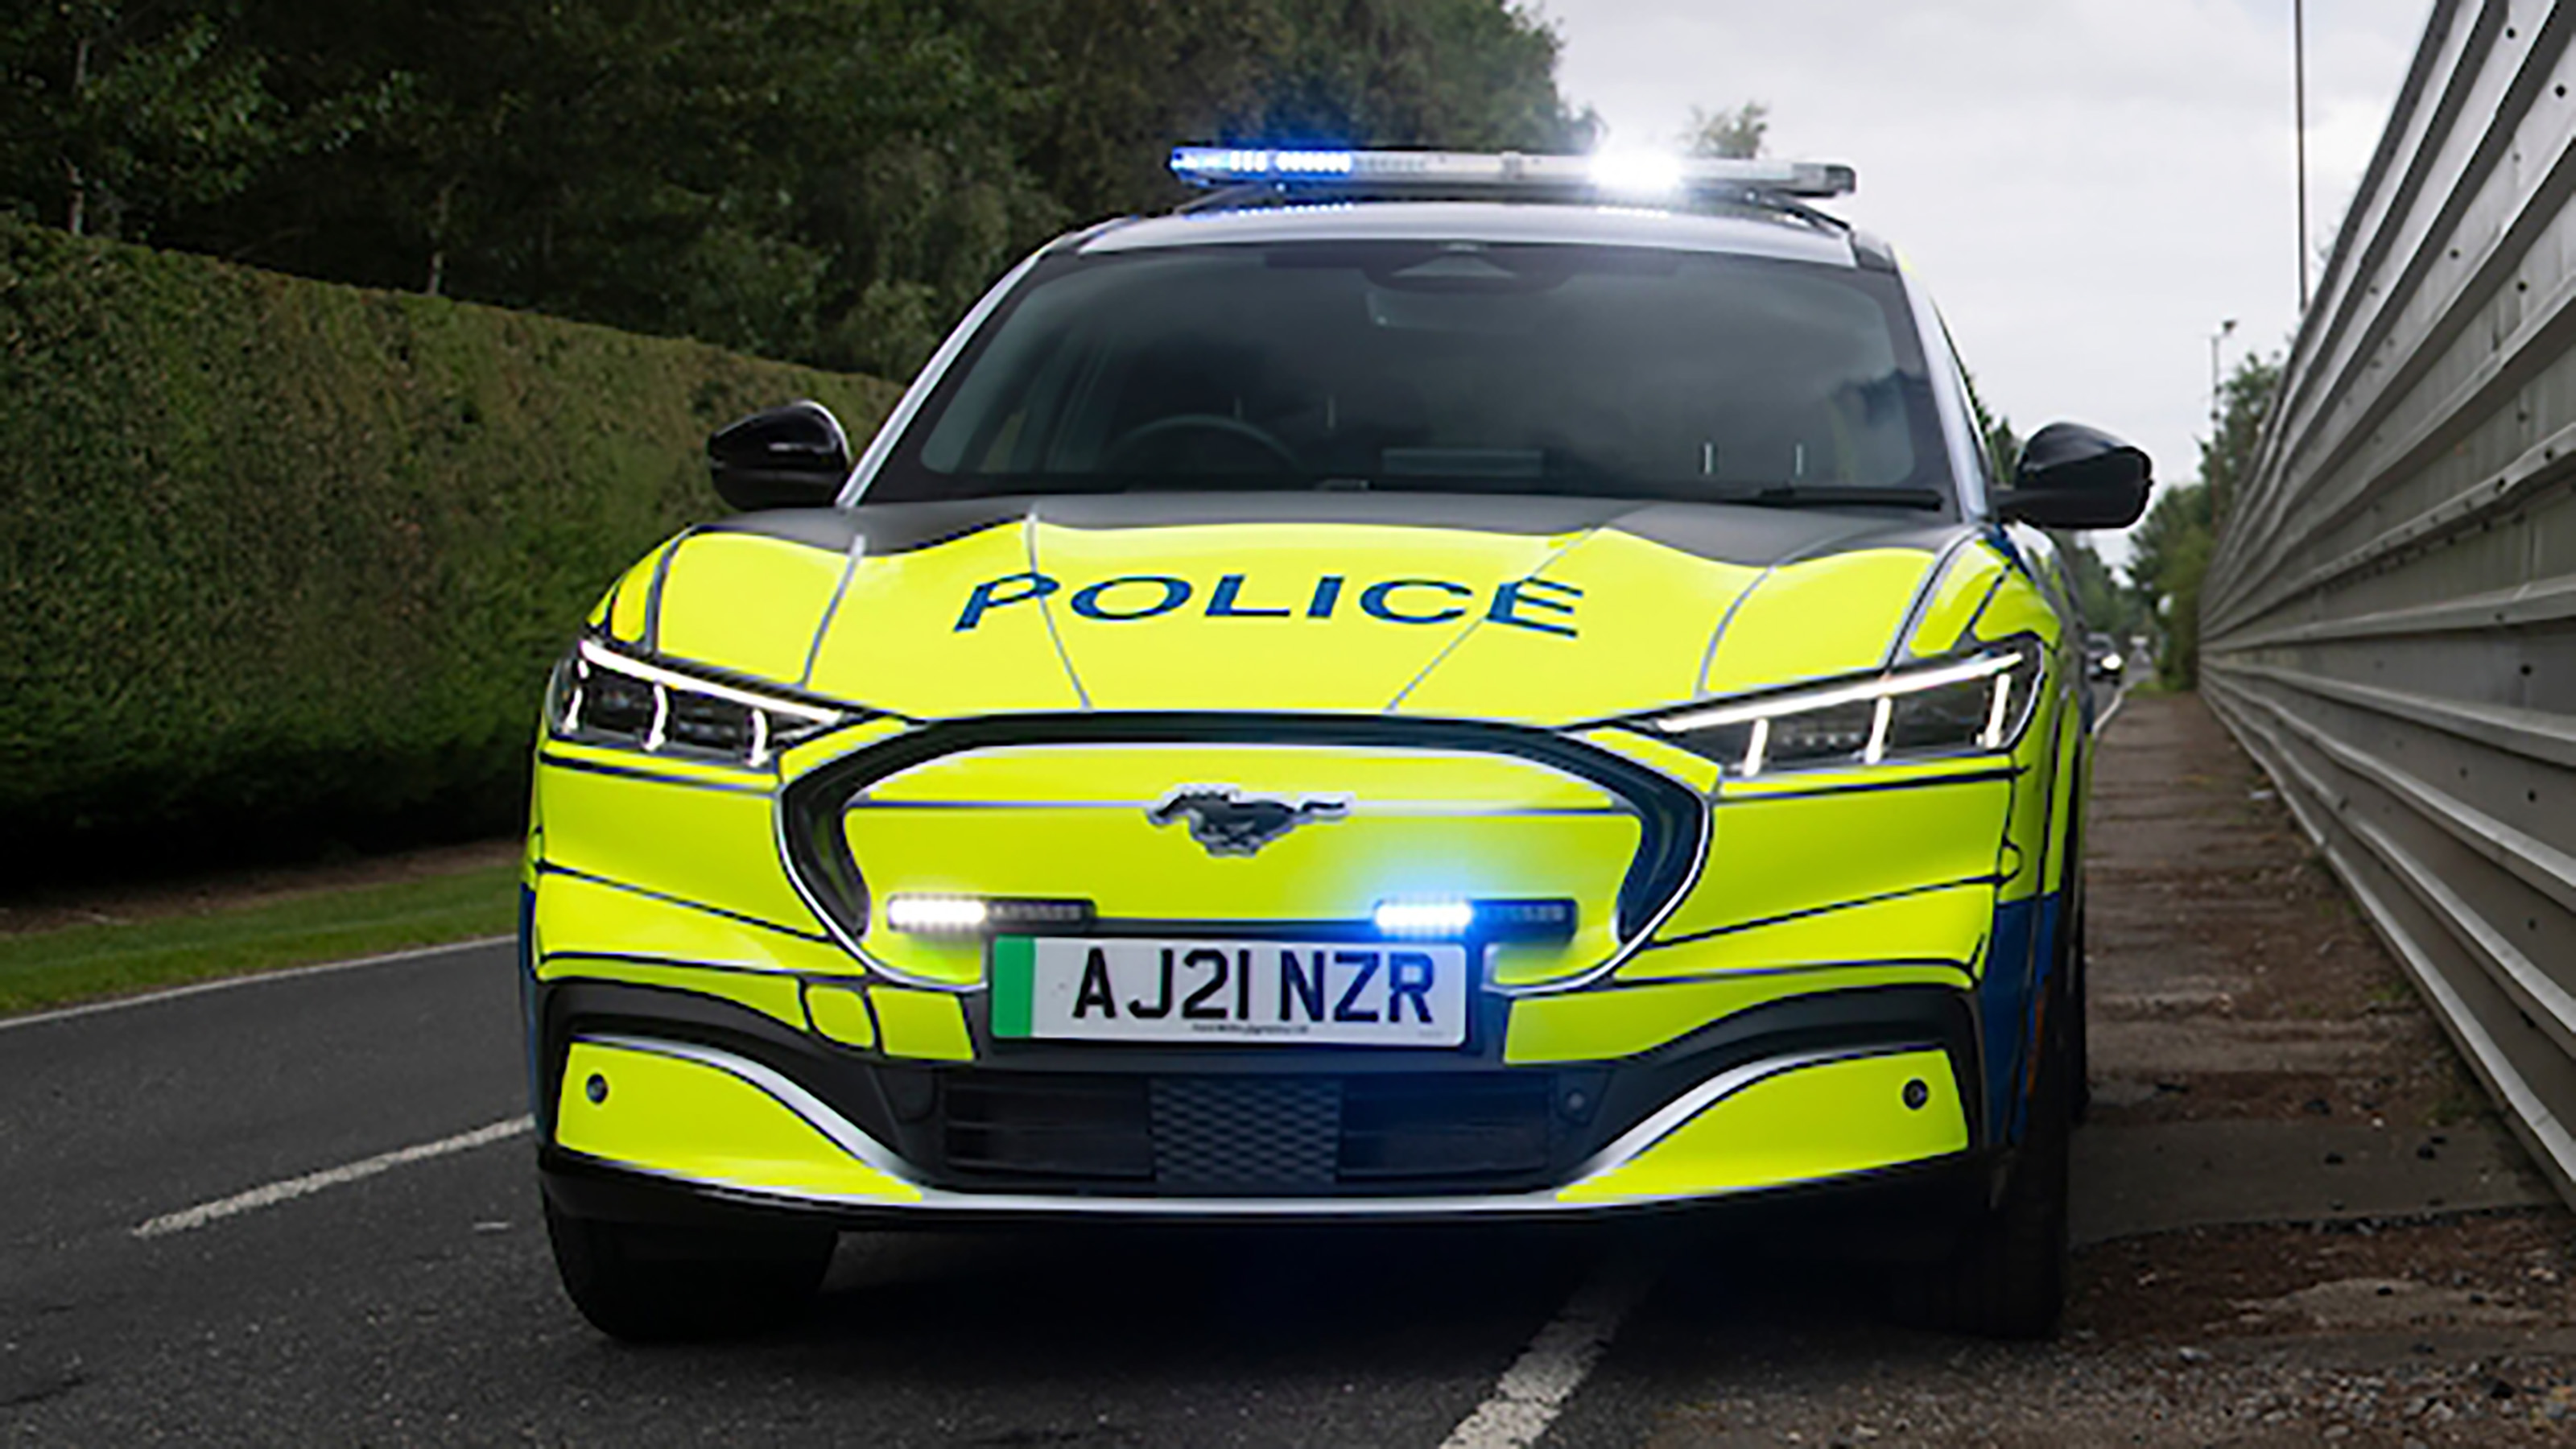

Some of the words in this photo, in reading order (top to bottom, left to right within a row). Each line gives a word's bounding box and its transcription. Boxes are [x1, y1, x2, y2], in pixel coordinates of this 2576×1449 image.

[953, 570, 1583, 638] POLICE
[1071, 947, 1252, 1021] AJ21
[1278, 950, 1435, 1024] NZR
